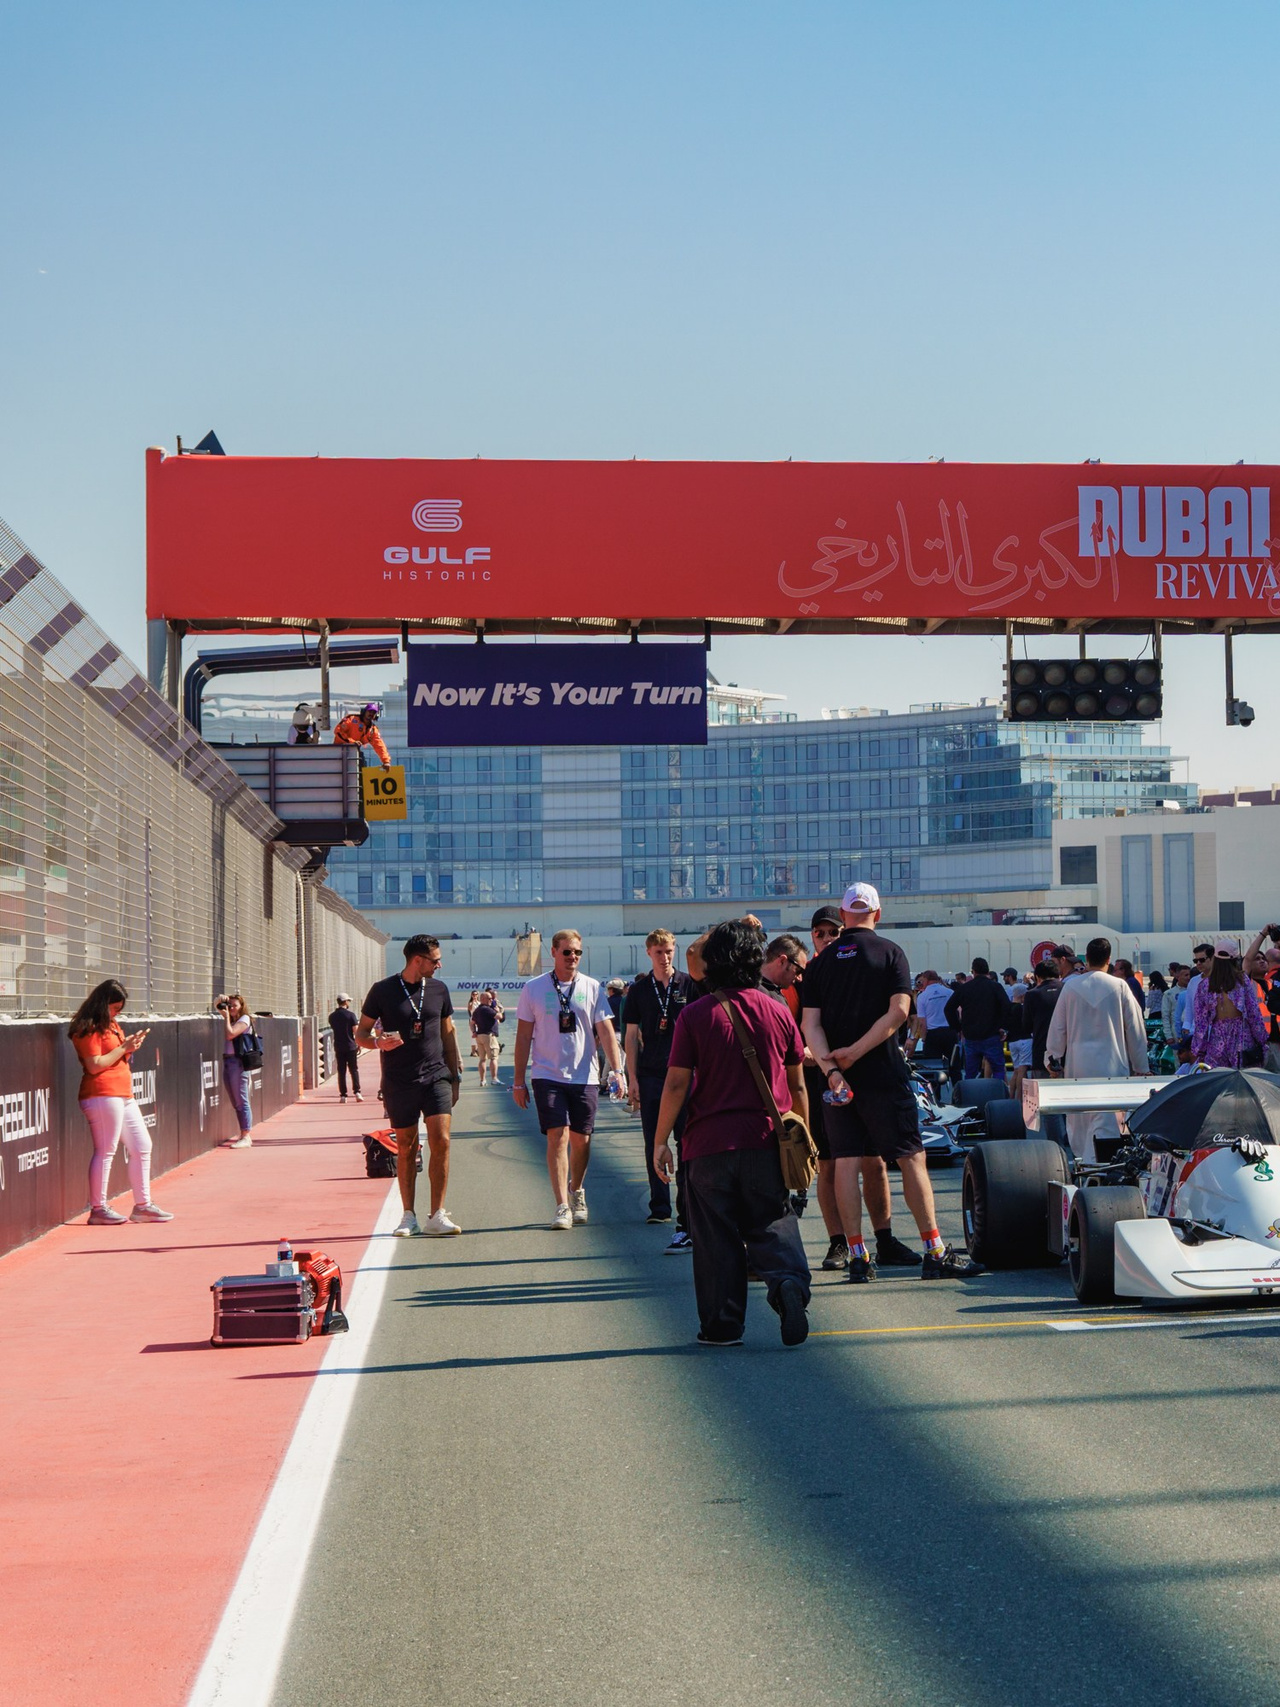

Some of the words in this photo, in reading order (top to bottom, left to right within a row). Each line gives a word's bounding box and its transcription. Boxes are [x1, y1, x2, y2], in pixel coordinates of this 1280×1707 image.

[1077, 486, 1272, 558] DUBAI
[383, 546, 491, 564] GULF
[777, 498, 973, 614] التاريخي
[383, 571, 491, 581] HISTORIC
[413, 683, 487, 707] Now
[490, 683, 542, 706] It's
[550, 682, 624, 706] Your
[630, 682, 703, 705] Turn
[369, 777, 398, 796] 10
[366, 798, 404, 806] MINUTES
[457, 981, 481, 989] NOW
[482, 981, 500, 989] IT'S
